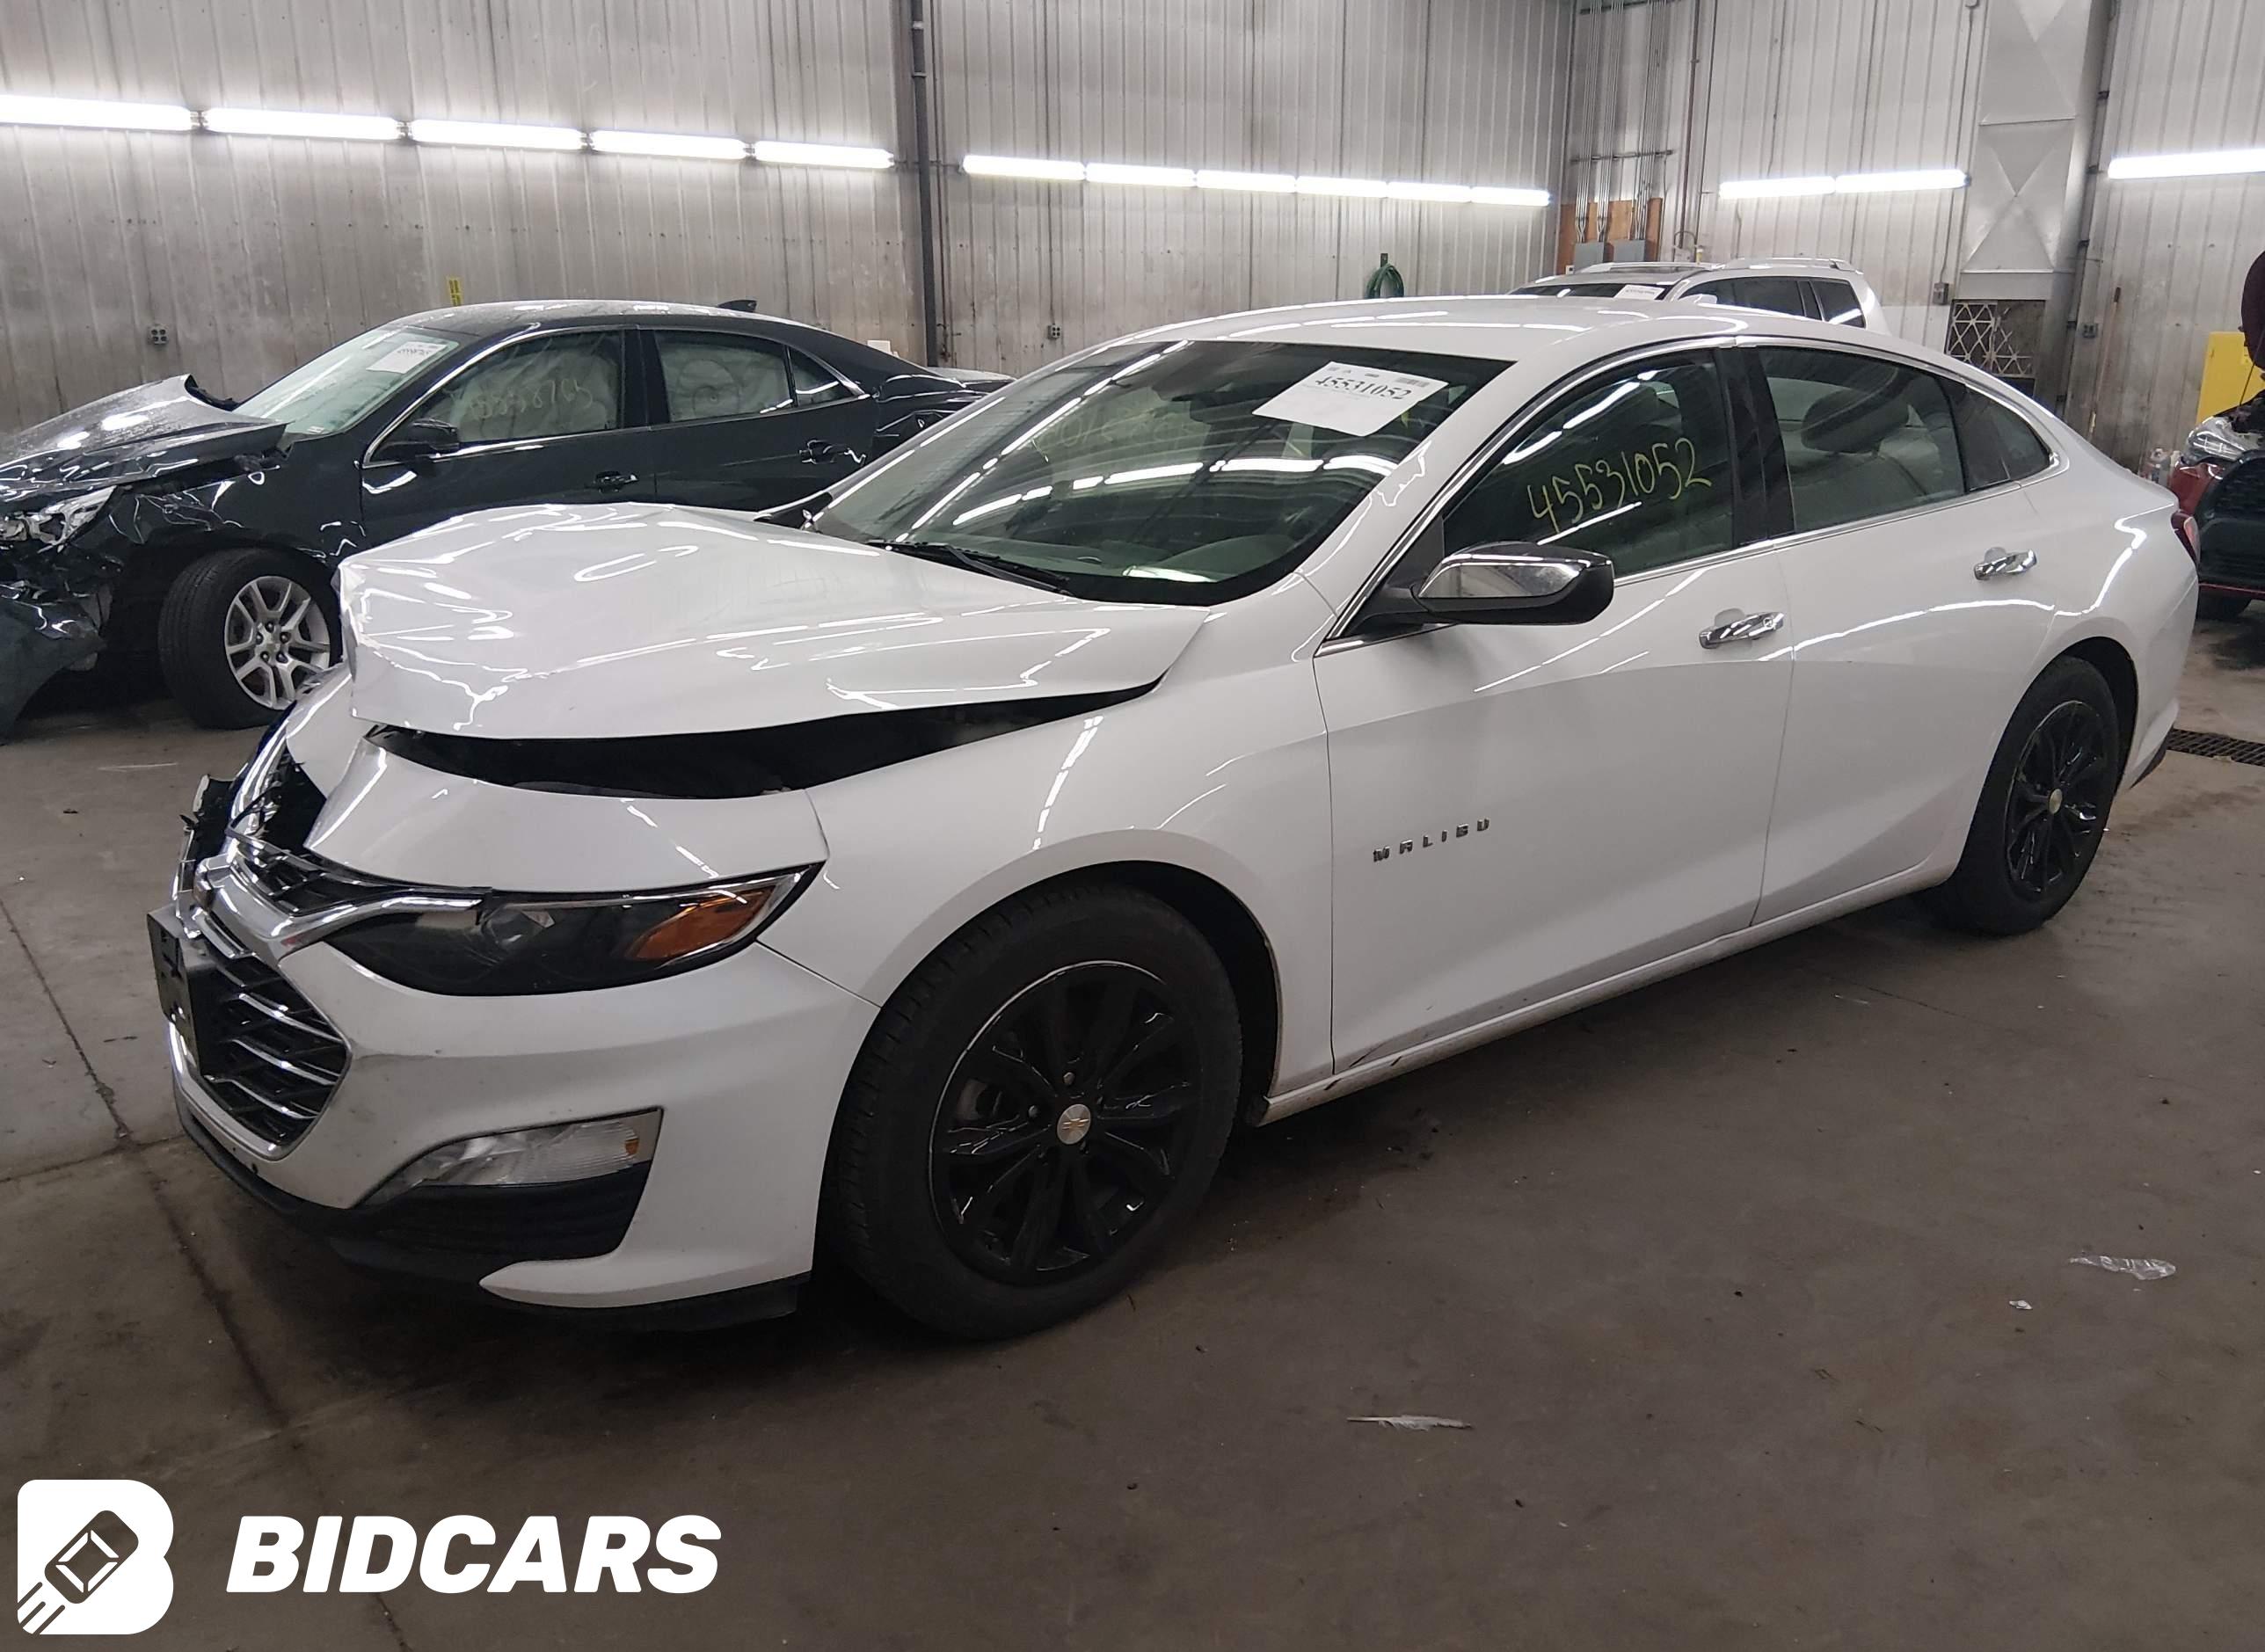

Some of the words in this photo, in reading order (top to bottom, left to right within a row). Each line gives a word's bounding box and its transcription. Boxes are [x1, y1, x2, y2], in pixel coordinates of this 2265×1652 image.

[1315, 376, 1412, 400] 45531052
[1526, 437, 1713, 534] 45531052
[1373, 818, 1490, 862] MALIBU
